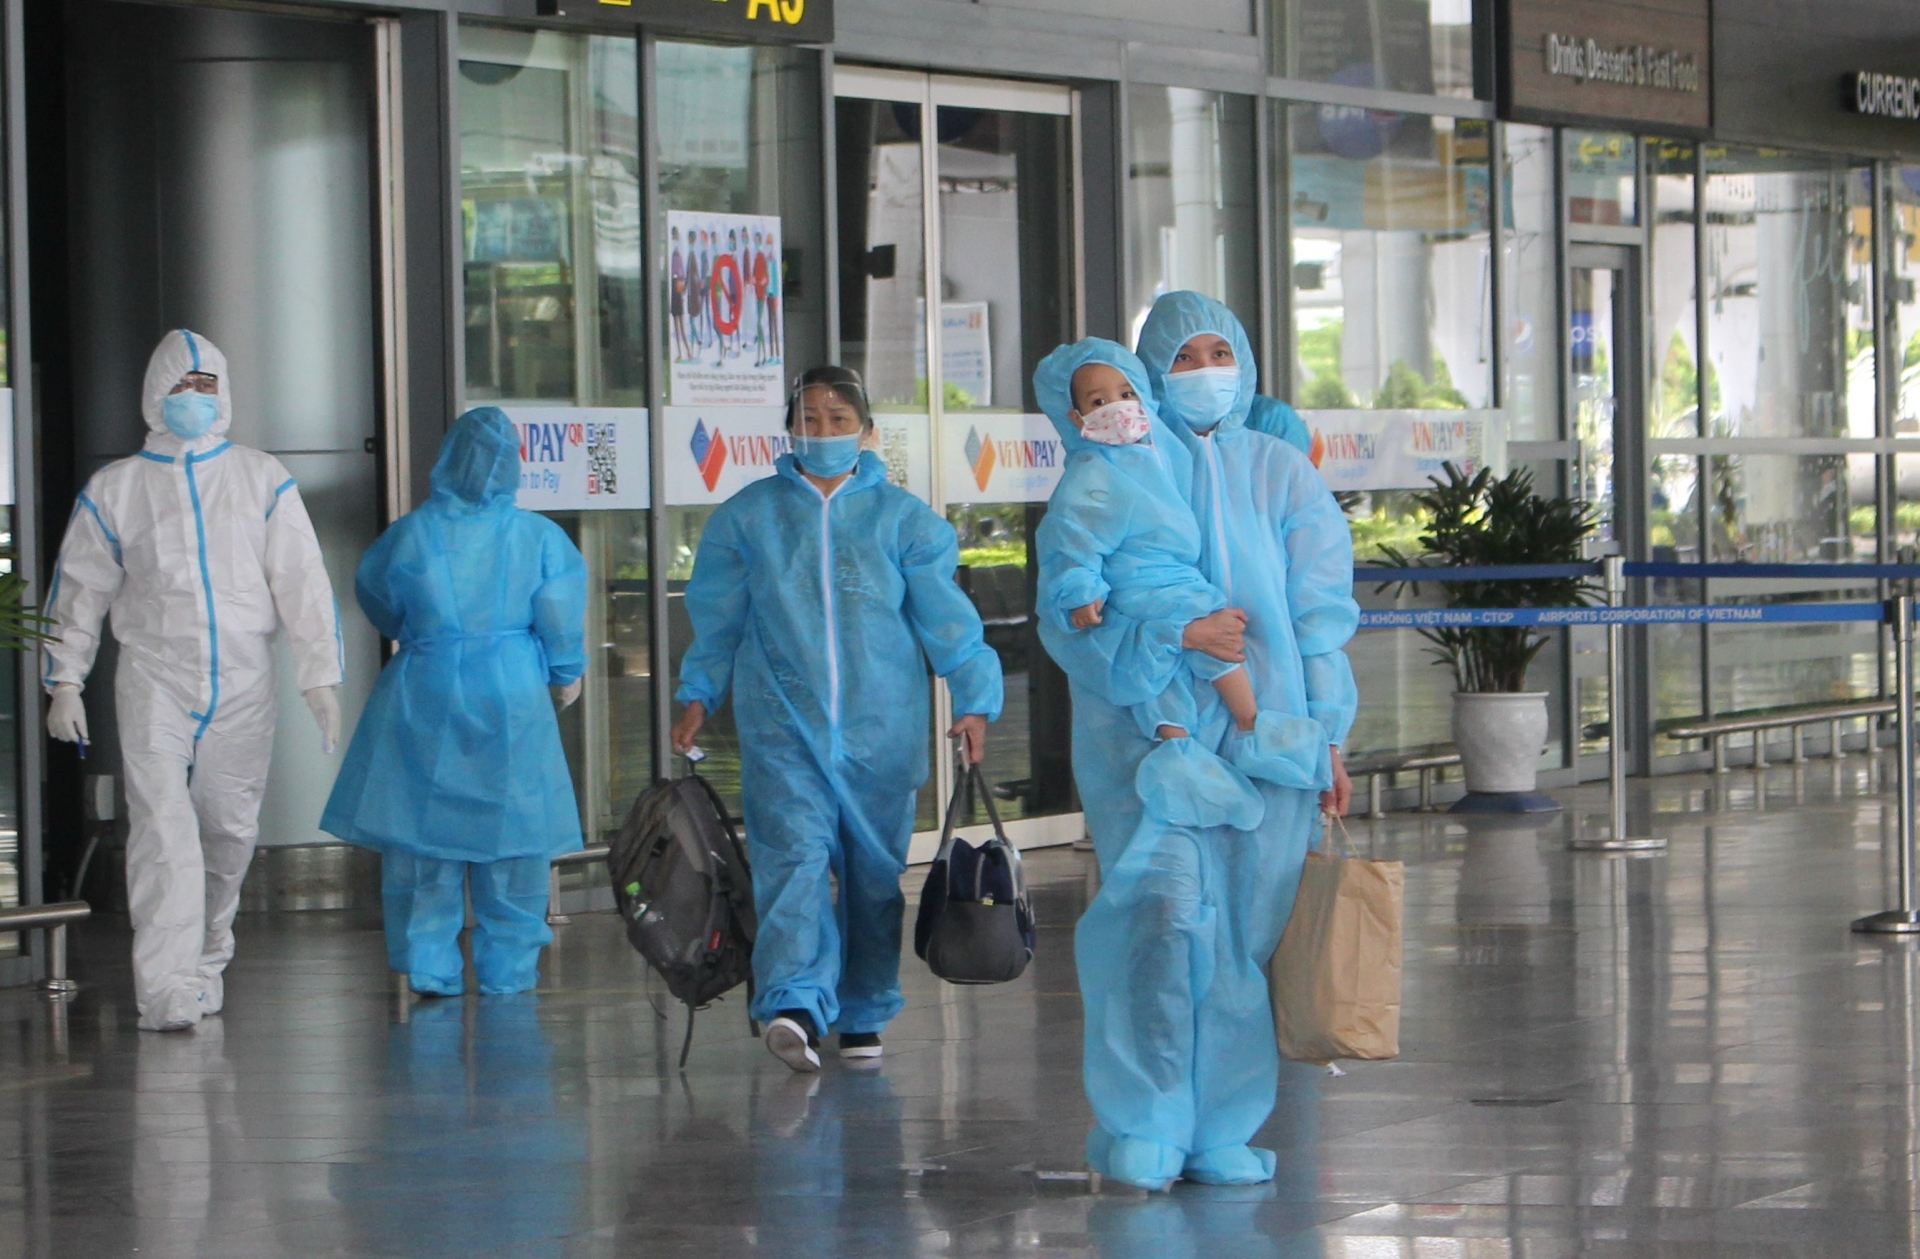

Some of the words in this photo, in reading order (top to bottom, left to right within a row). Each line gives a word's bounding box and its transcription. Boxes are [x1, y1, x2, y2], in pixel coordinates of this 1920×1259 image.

[748, 435, 791, 466] VNPA
[1013, 440, 1057, 468] VNPAY
[1371, 612, 1413, 625] KHÔNG
[1445, 612, 1472, 623] NAM
[1482, 612, 1514, 623] CTCP
[1538, 611, 1597, 622] AIRPORTS
[1601, 608, 1685, 621] CORPORATION
[1689, 608, 1704, 620] OF
[1706, 608, 1762, 620] VIETNAM
